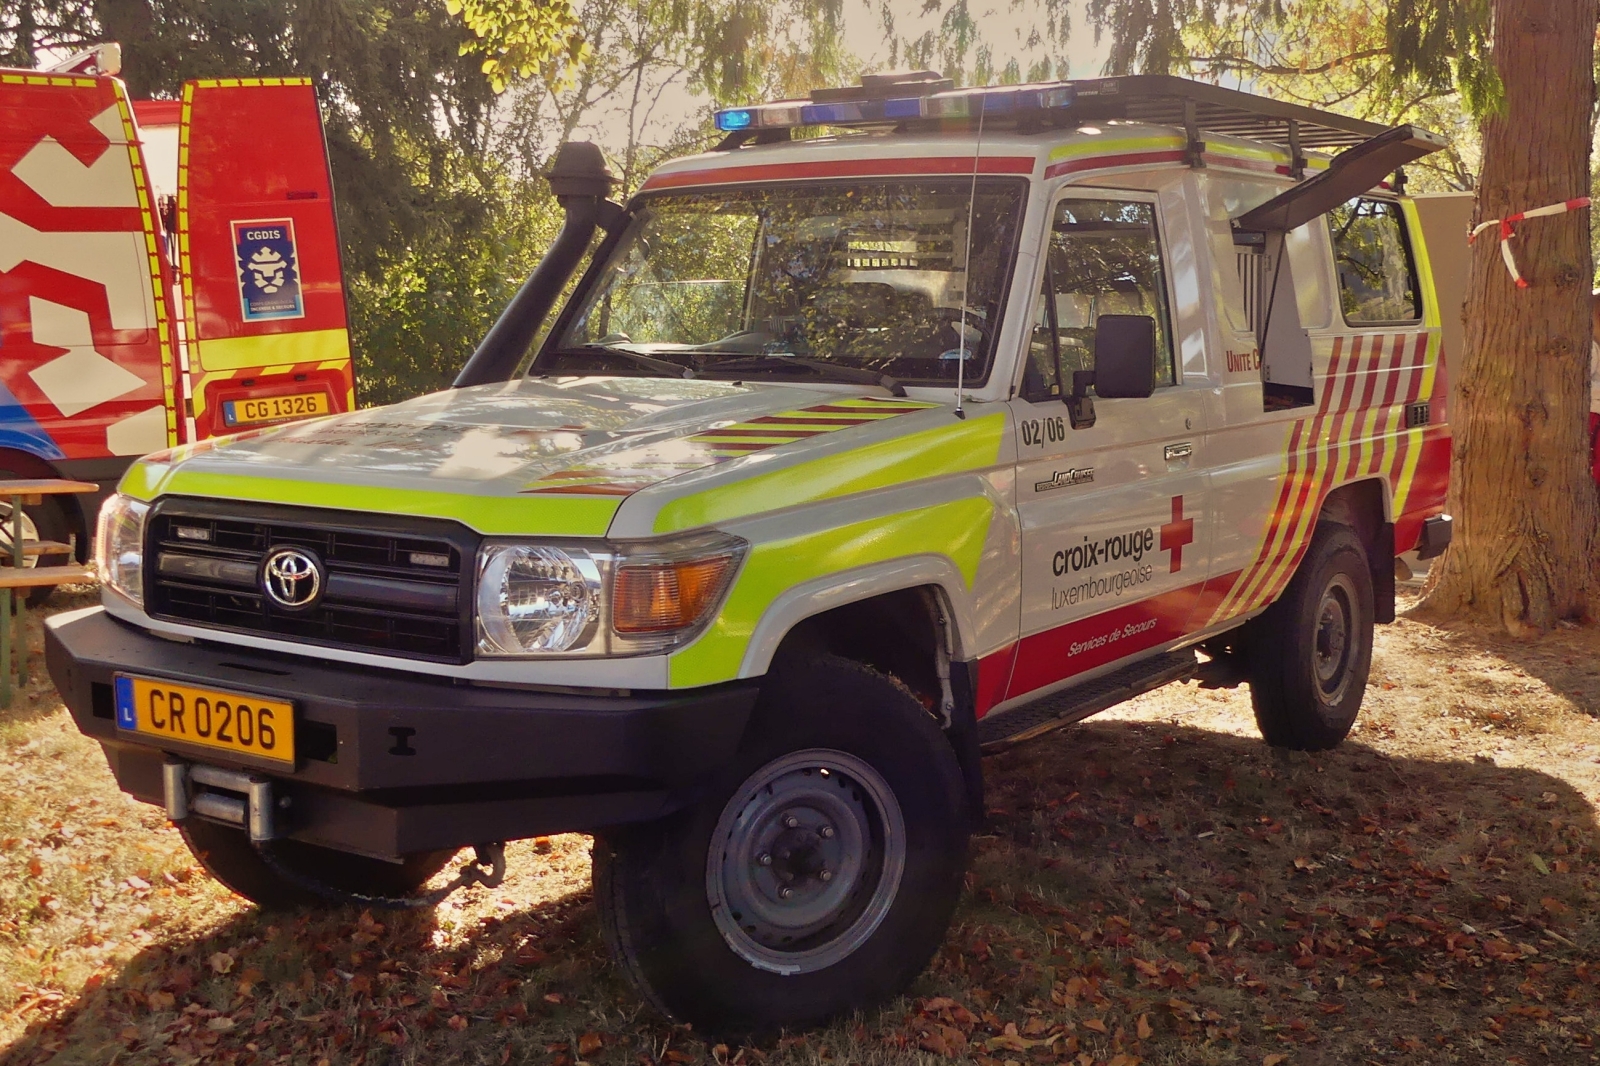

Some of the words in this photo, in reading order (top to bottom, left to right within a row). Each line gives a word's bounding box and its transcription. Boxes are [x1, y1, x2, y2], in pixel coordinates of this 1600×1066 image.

[246, 230, 281, 240] CGDIS
[245, 402, 269, 419] CG
[273, 396, 317, 416] 1326
[1021, 416, 1065, 449] 02/06
[1052, 527, 1154, 577] croix-rouge
[1051, 562, 1153, 611] luxembourgeoise
[1067, 634, 1107, 657] Services
[1108, 627, 1121, 641] de
[1121, 617, 1158, 638] Secours
[123, 707, 132, 721] L
[149, 689, 187, 734] CR
[194, 696, 276, 750] 0206
